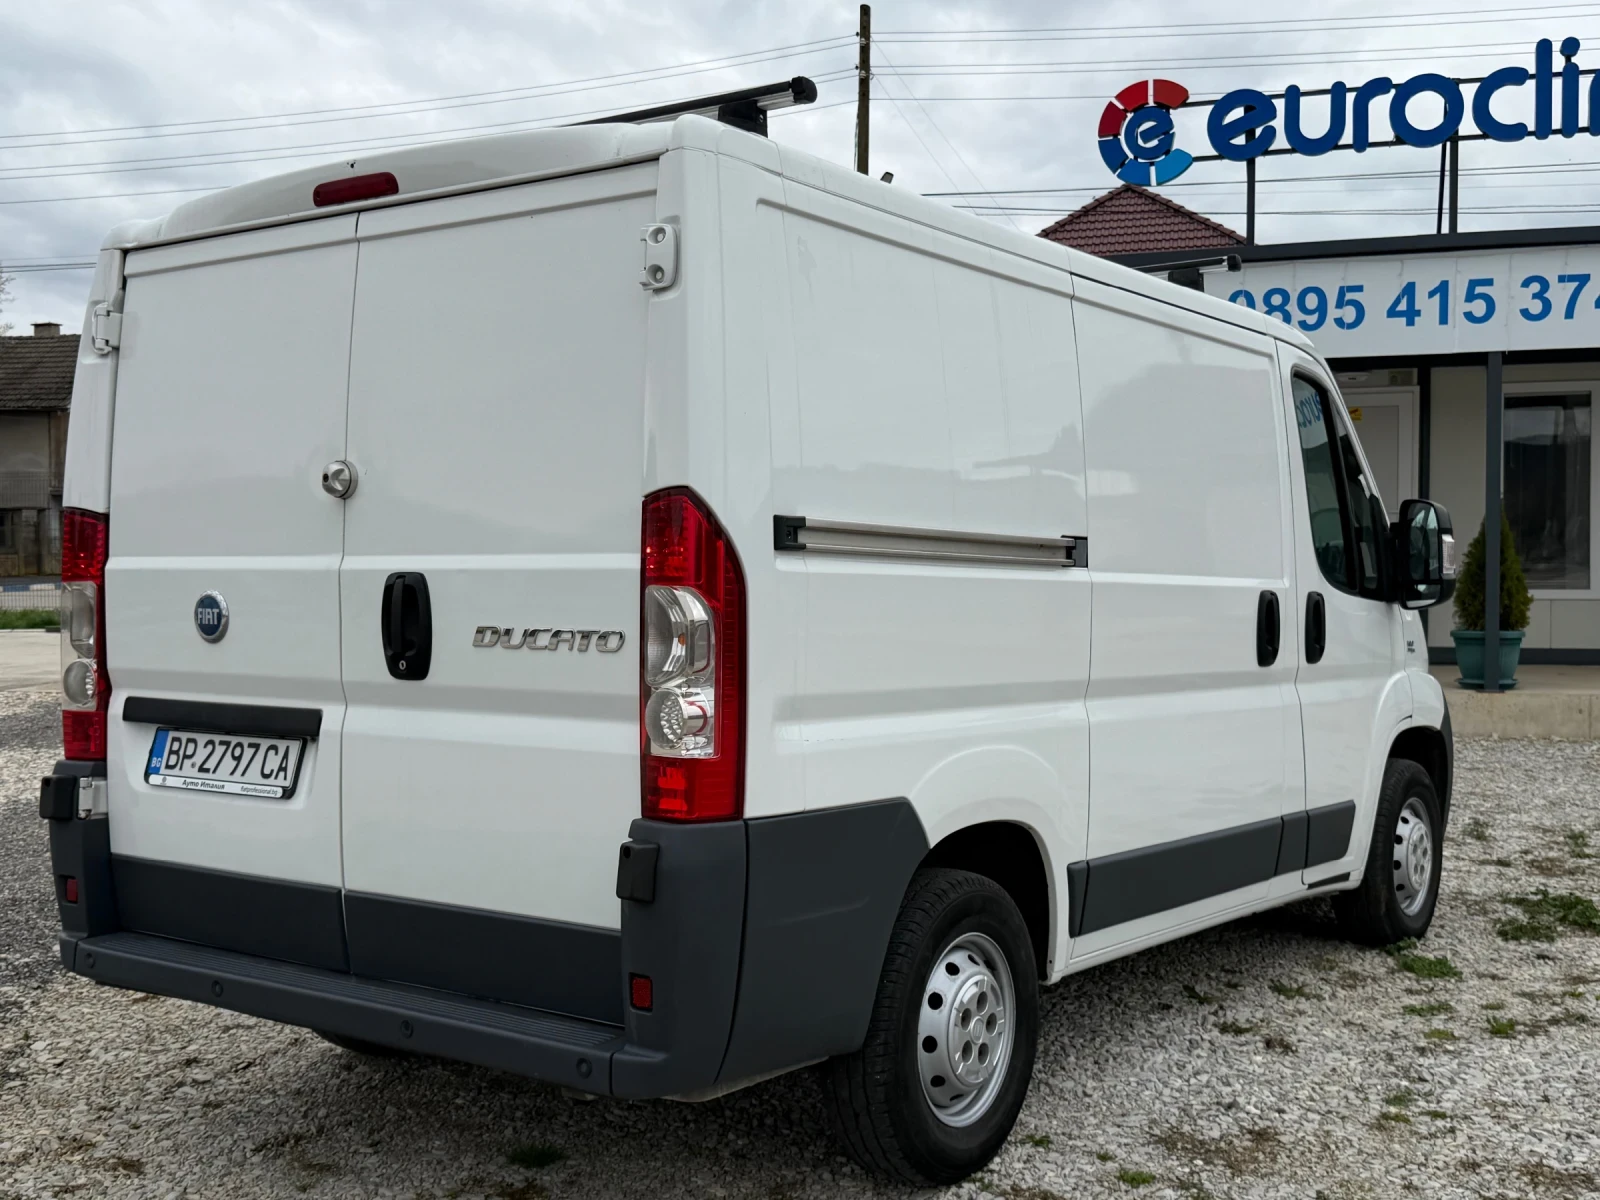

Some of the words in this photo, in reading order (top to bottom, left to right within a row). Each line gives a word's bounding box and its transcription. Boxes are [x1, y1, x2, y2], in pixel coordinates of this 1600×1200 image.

[1206, 36, 1600, 162] eurocli
[1386, 278, 1496, 327] 415
[1519, 273, 1600, 322] 37
[197, 607, 220, 625] FIAT
[472, 625, 626, 653] DUCATO
[151, 757, 162, 768] BG
